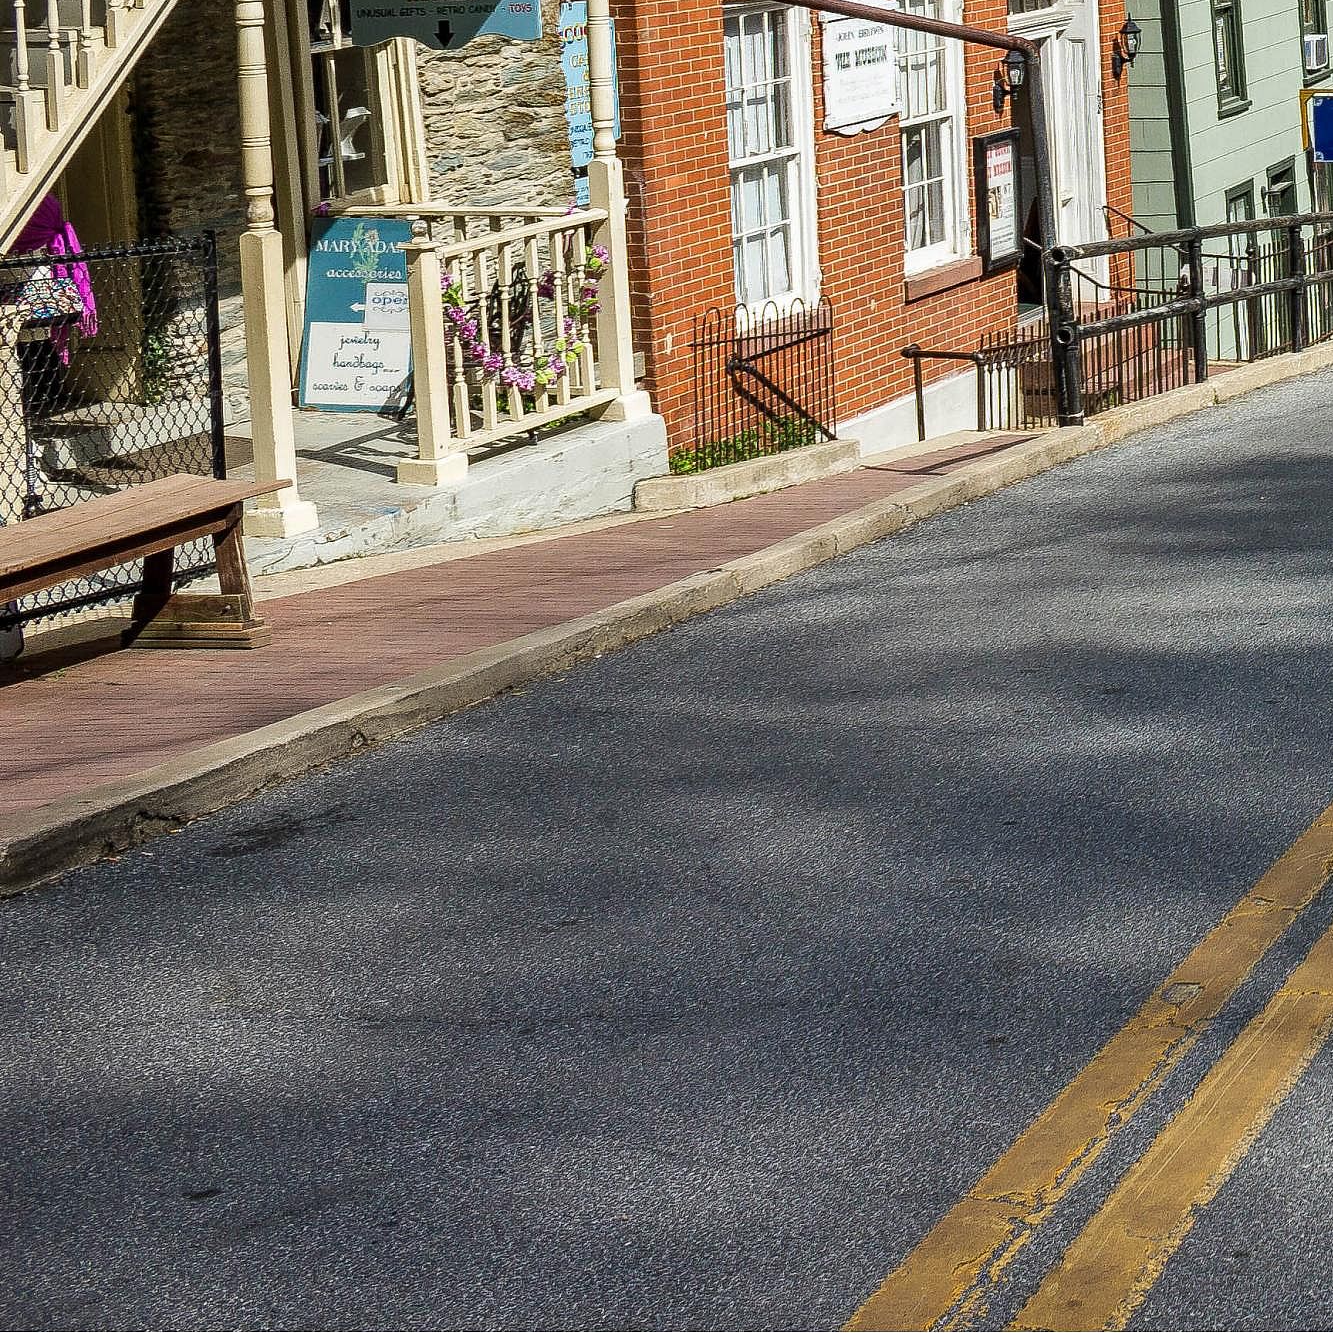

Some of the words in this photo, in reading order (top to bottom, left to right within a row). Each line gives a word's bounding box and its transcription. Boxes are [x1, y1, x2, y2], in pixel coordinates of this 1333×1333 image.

[436, 6, 465, 15] RETRO
[508, 3, 533, 13] TOYS
[315, 239, 358, 253] MARY
[326, 266, 402, 279] accessories
[338, 331, 381, 351] jewelry
[353, 375, 365, 392] &
